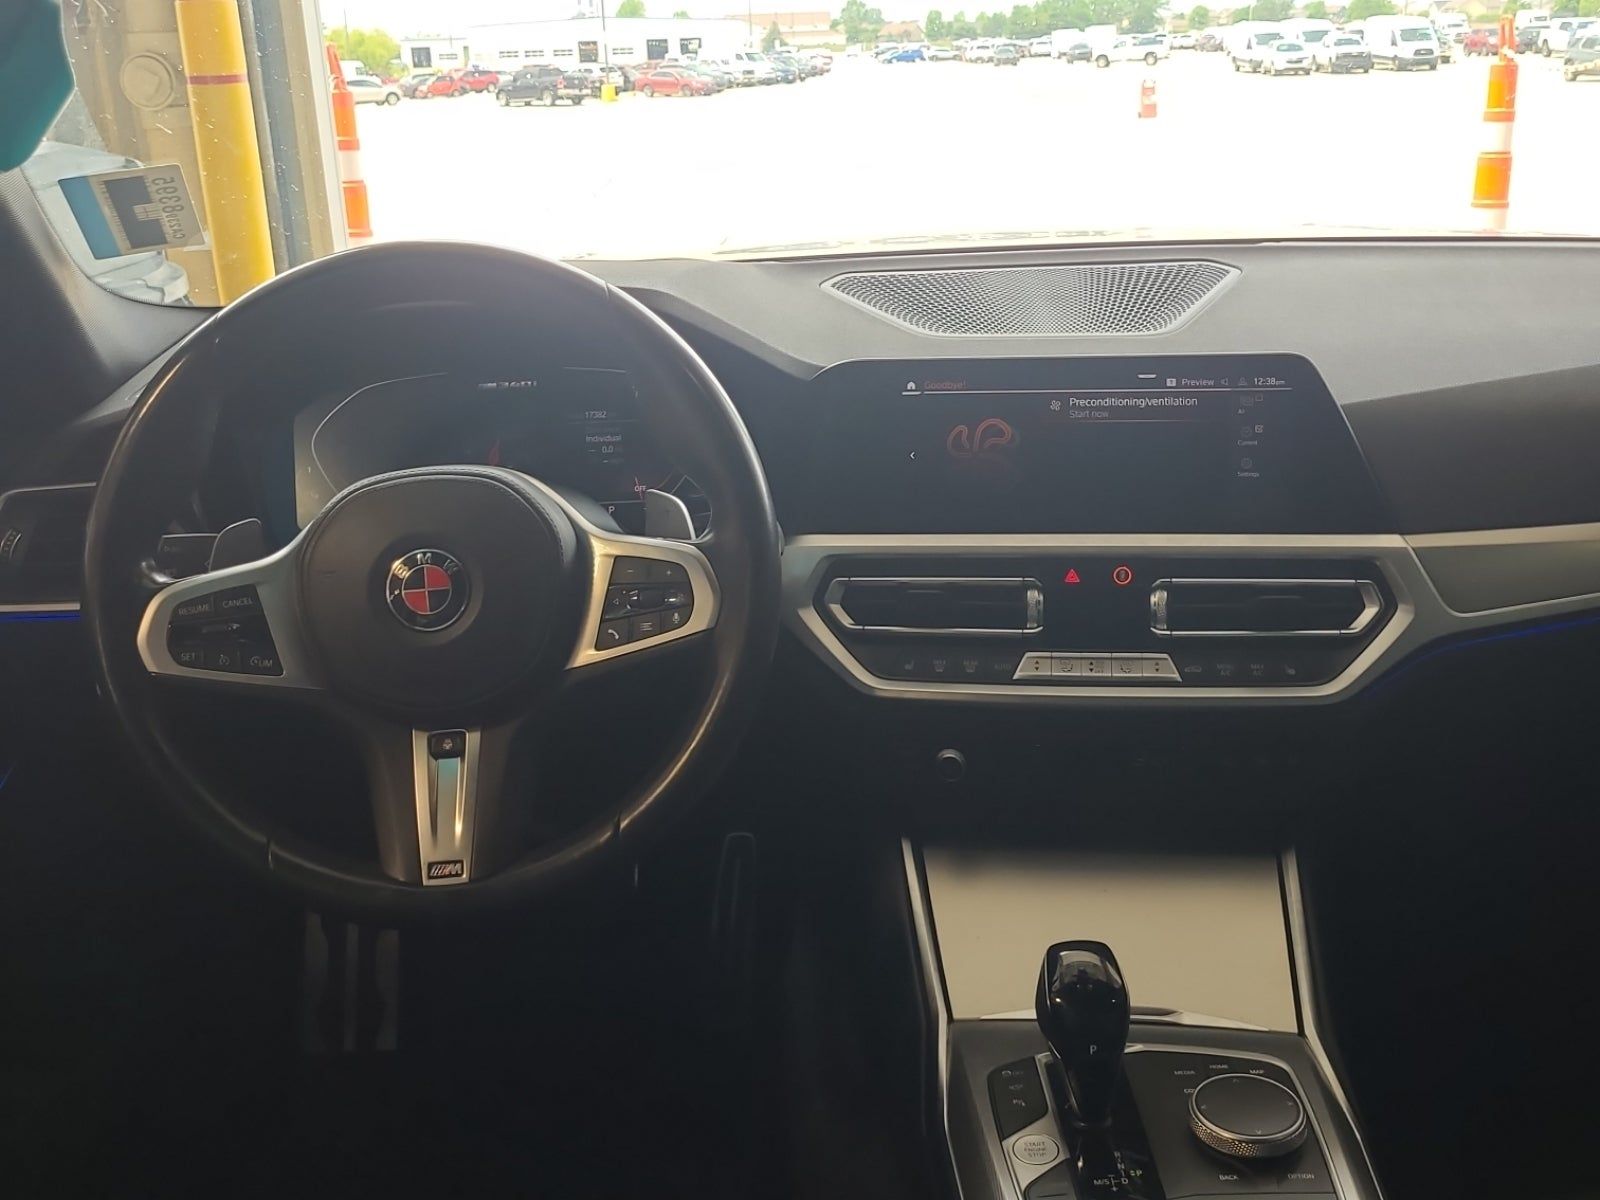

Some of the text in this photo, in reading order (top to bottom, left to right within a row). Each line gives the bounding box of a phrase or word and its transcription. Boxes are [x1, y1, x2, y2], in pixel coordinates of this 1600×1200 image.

[1182, 378, 1215, 387] Preview
[1069, 396, 1198, 409] Preconditioning/ventilation
[1069, 409, 1109, 419] Start now
[585, 433, 622, 443] Individual
[634, 485, 647, 493] OFF
[608, 505, 616, 515] P
[394, 552, 459, 579] BMW
[222, 596, 255, 609] CANCEL
[178, 602, 210, 617] RESUME
[181, 652, 196, 662] SET
[1090, 1044, 1097, 1055] P
